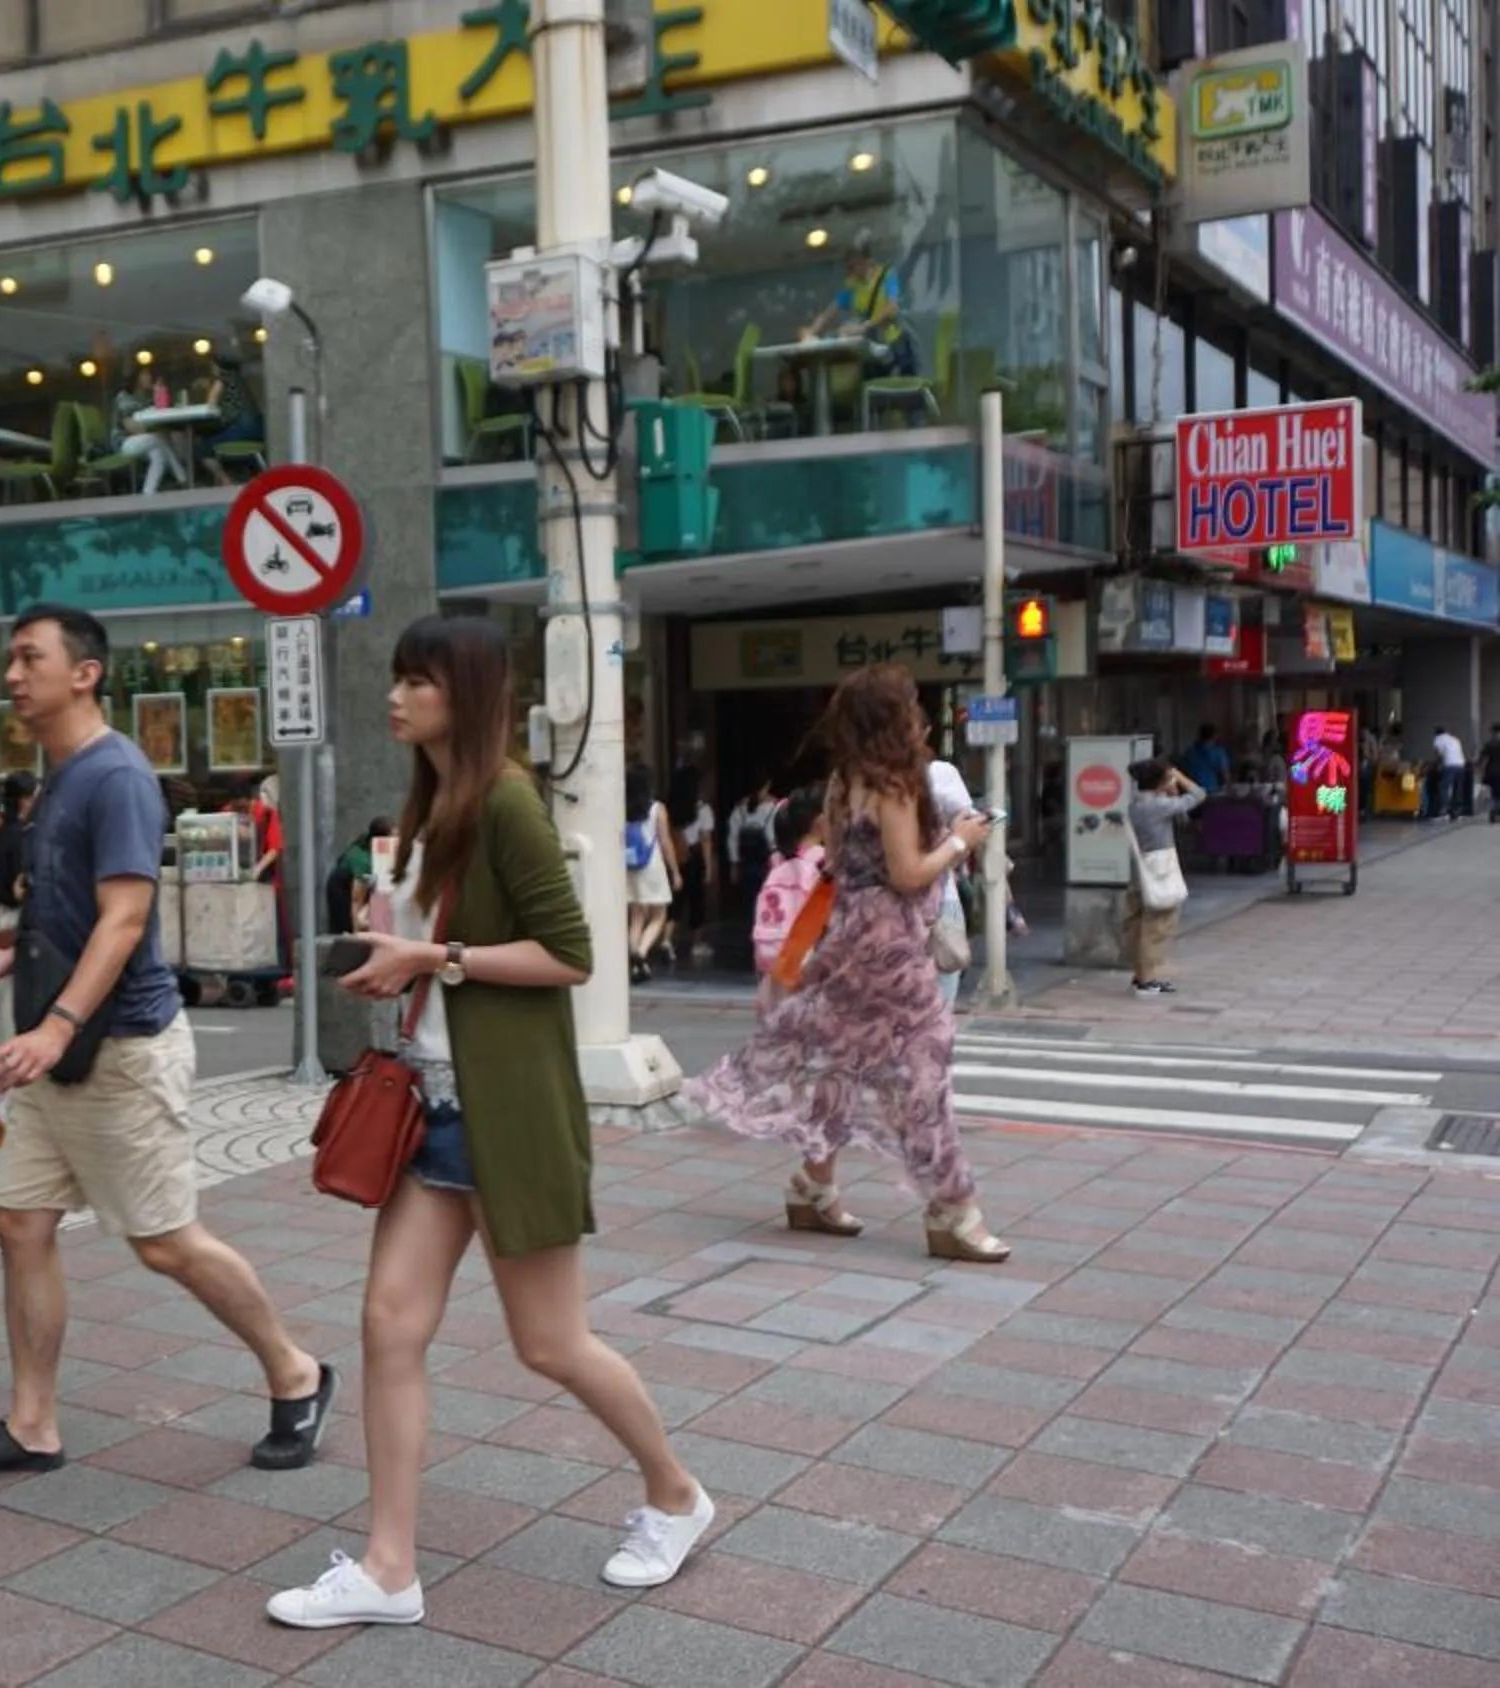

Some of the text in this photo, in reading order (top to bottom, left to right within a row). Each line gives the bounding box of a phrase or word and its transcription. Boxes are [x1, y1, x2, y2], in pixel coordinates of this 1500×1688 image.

[1188, 408, 1347, 480] Chian Huei
[1188, 473, 1348, 544] HOTEL
